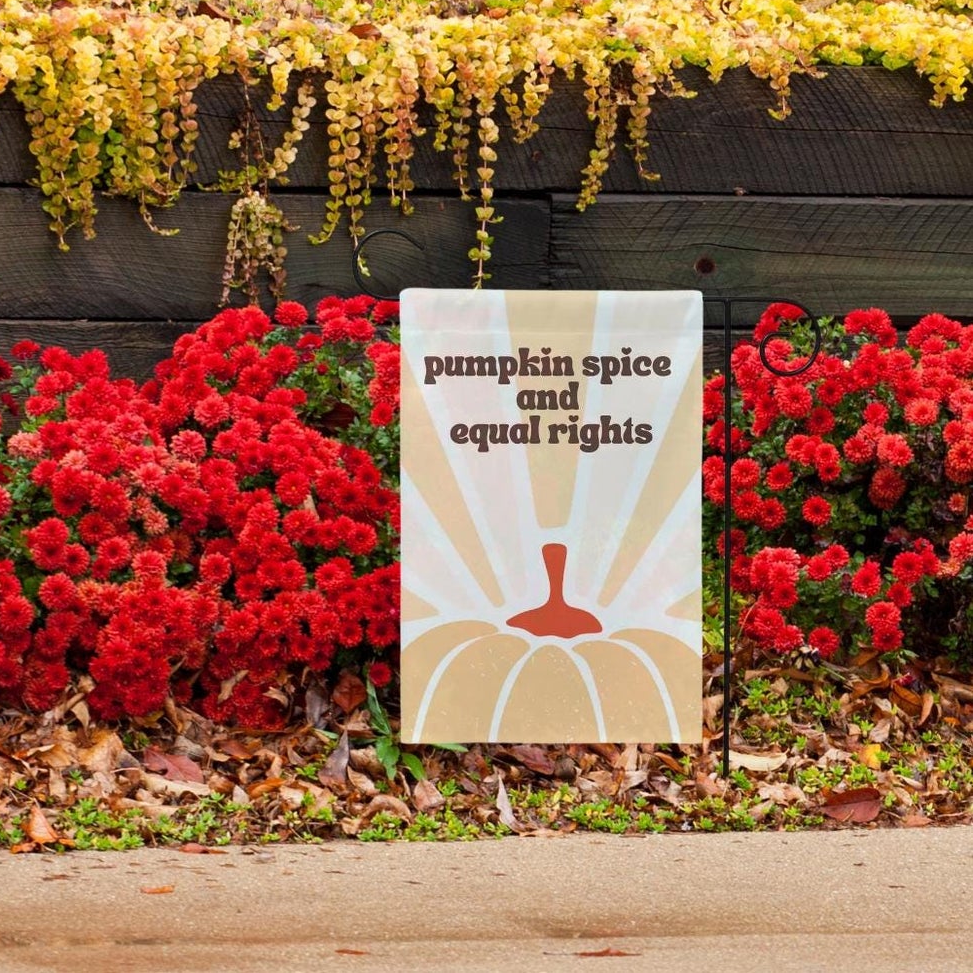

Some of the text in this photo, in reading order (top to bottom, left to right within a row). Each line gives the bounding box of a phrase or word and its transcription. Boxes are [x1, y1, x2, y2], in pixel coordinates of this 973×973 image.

[424, 347, 671, 385] pumpkin spice
[517, 382, 579, 410] and
[450, 415, 653, 452] equal rights
